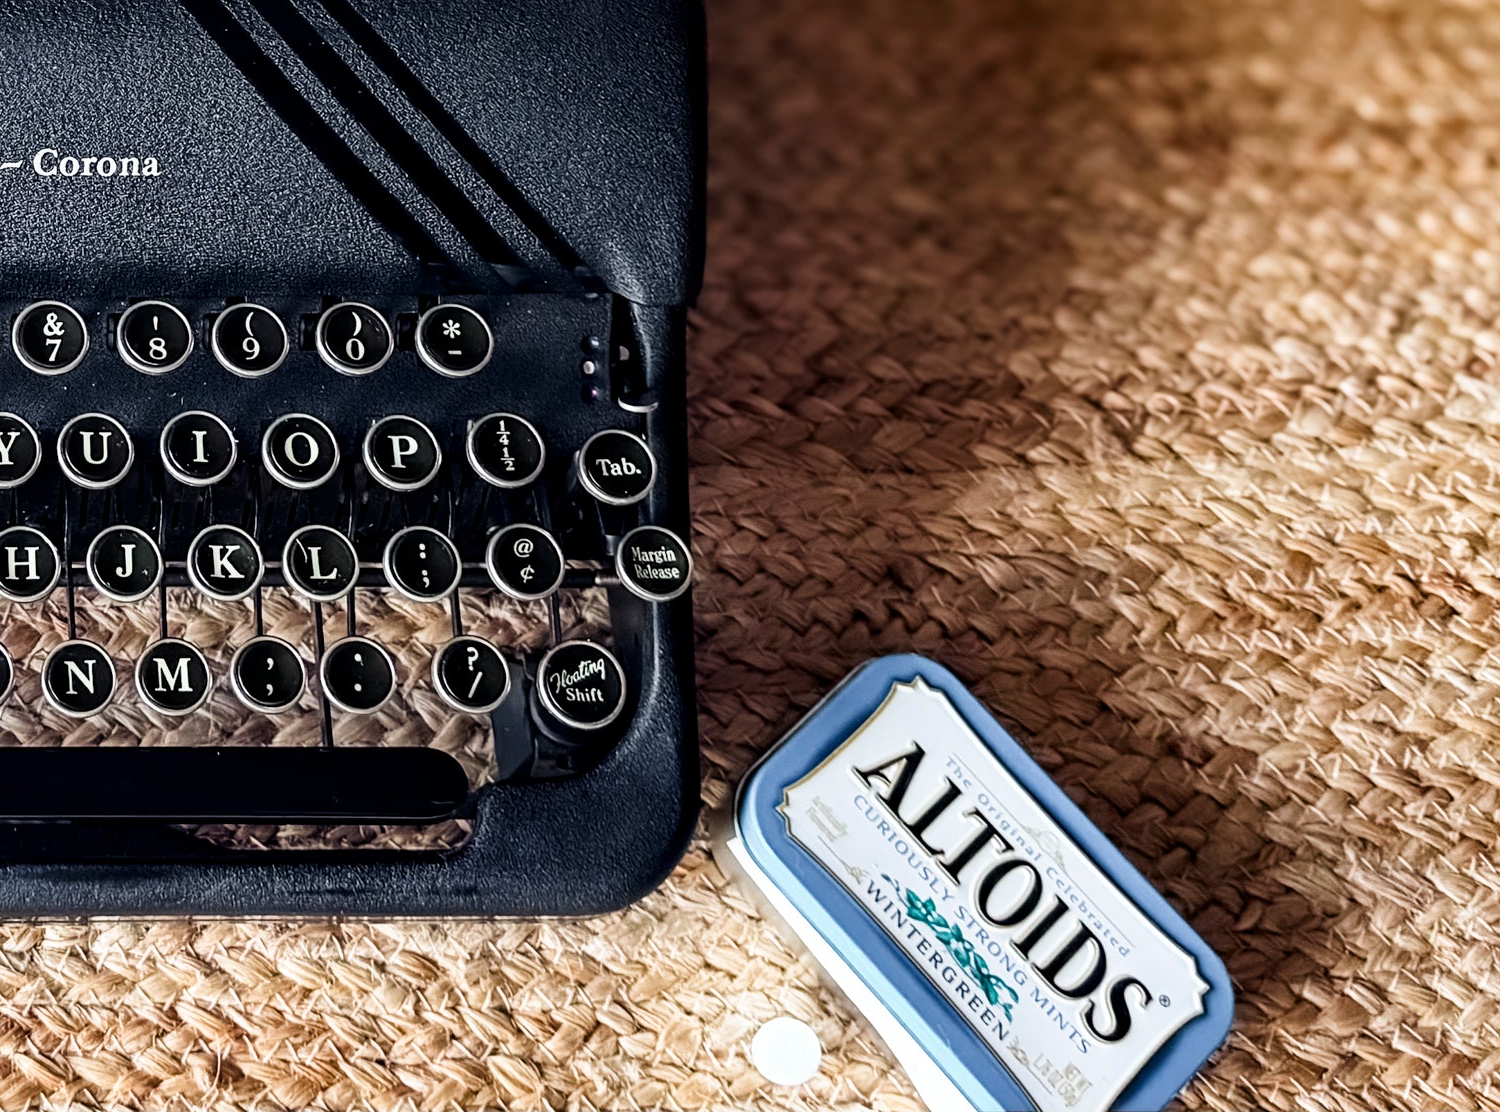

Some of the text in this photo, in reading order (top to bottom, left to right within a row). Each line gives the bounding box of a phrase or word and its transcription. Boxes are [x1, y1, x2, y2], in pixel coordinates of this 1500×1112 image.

[33, 147, 162, 178] Corona
[46, 339, 61, 361] 7
[149, 338, 167, 359] 8
[243, 337, 260, 360] 9
[80, 431, 111, 464] U
[192, 431, 209, 462] I
[285, 432, 318, 466] O
[388, 436, 418, 468] P
[596, 458, 641, 476] Tab.
[5, 547, 40, 579] H
[116, 544, 136, 577] J
[209, 545, 244, 578] K
[308, 547, 337, 579] L
[632, 546, 676, 563] Margin
[635, 565, 679, 578] Release
[64, 660, 96, 694] N
[153, 658, 193, 691] M
[550, 659, 605, 694] Floating
[566, 689, 603, 701] Shift
[946, 758, 1131, 957] The Original Celebrated
[851, 740, 1153, 1045] ALTOIDS
[853, 795, 1092, 1054] CURIOUSLY STRONG MINTS
[867, 880, 1010, 1041] WINTERGREEN
